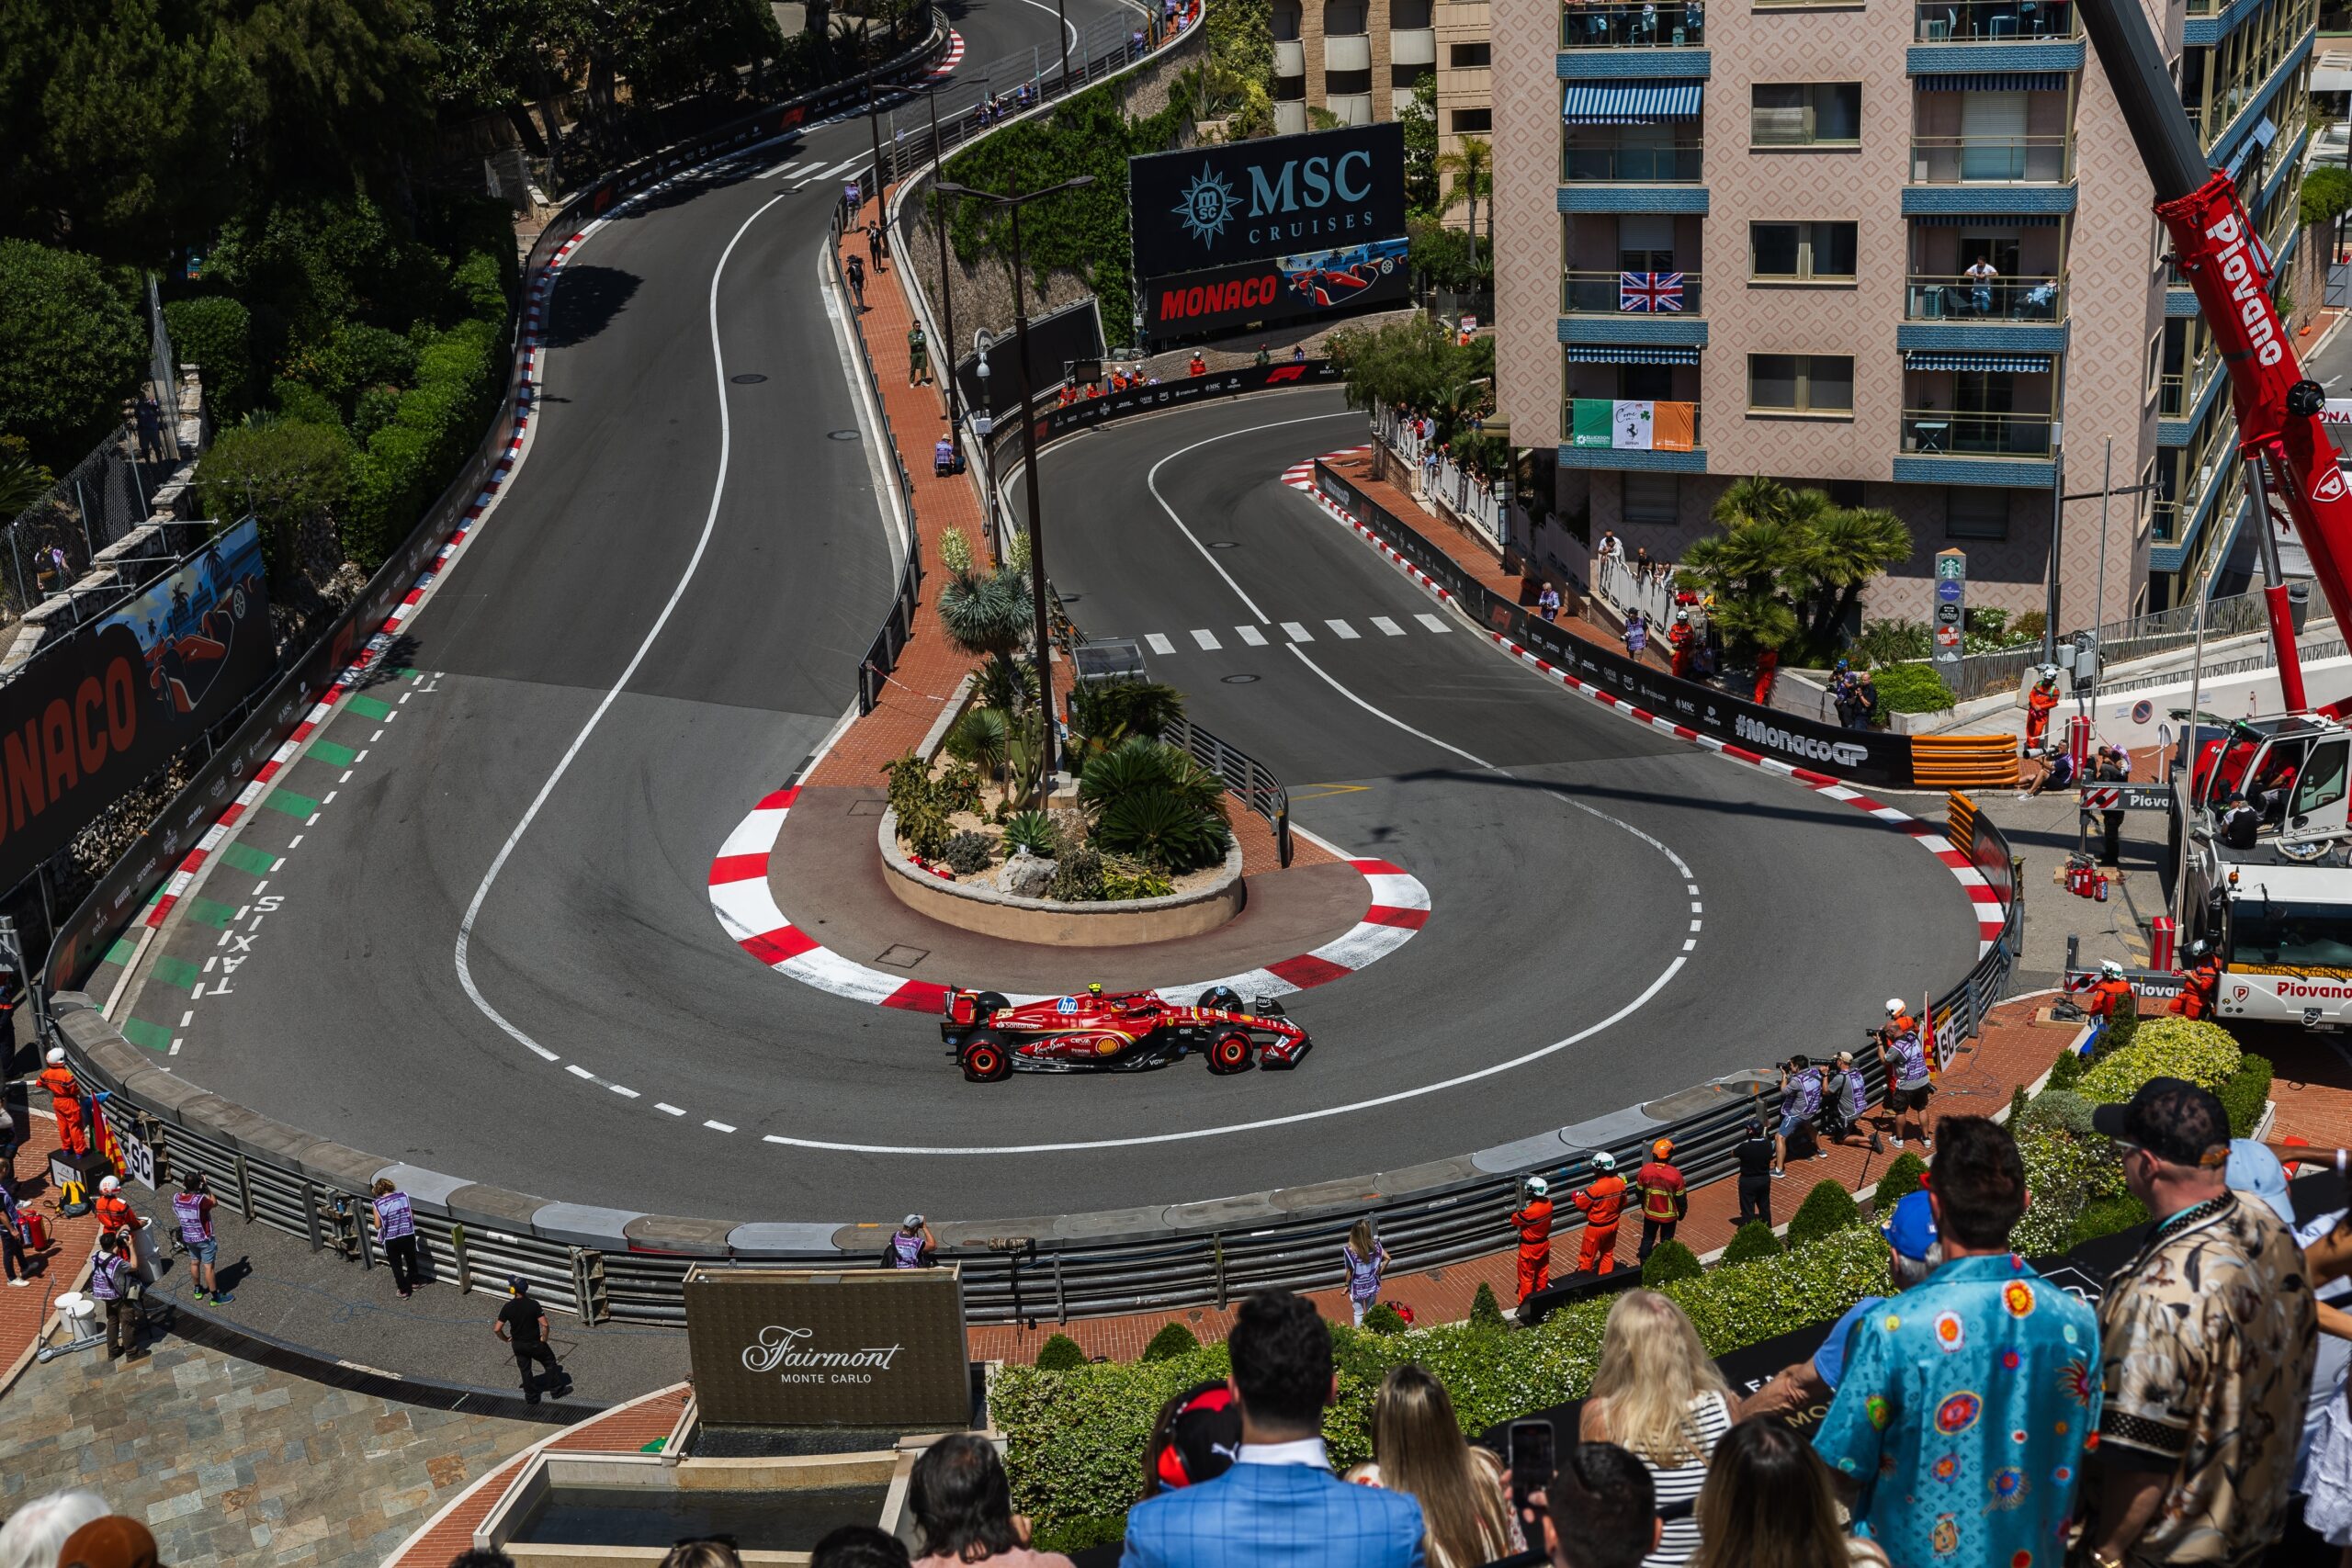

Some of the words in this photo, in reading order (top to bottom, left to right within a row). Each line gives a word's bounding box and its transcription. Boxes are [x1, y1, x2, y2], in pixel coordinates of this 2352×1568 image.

[1247, 151, 1372, 218] MSC
[1250, 211, 1373, 243] CRUISES
[1160, 276, 1277, 321] MONACO
[2206, 213, 2282, 366] Piovano
[1681, 699, 1695, 713] MSC
[0, 656, 137, 846] NACO
[1735, 714, 1869, 767] #MonacoGP
[137, 857, 156, 883] aramco
[205, 896, 286, 996] TAXIS
[1059, 997, 1076, 1015] hp
[2277, 981, 2352, 999] Piovano
[1006, 1021, 1040, 1030] Santander
[1940, 1025, 1954, 1064] SC
[1148, 1057, 1165, 1066] VGW
[130, 1143, 151, 1181] SC
[741, 1325, 905, 1372] Fairmont
[781, 1374, 825, 1383] MONTE
[831, 1373, 872, 1383] CARLO
